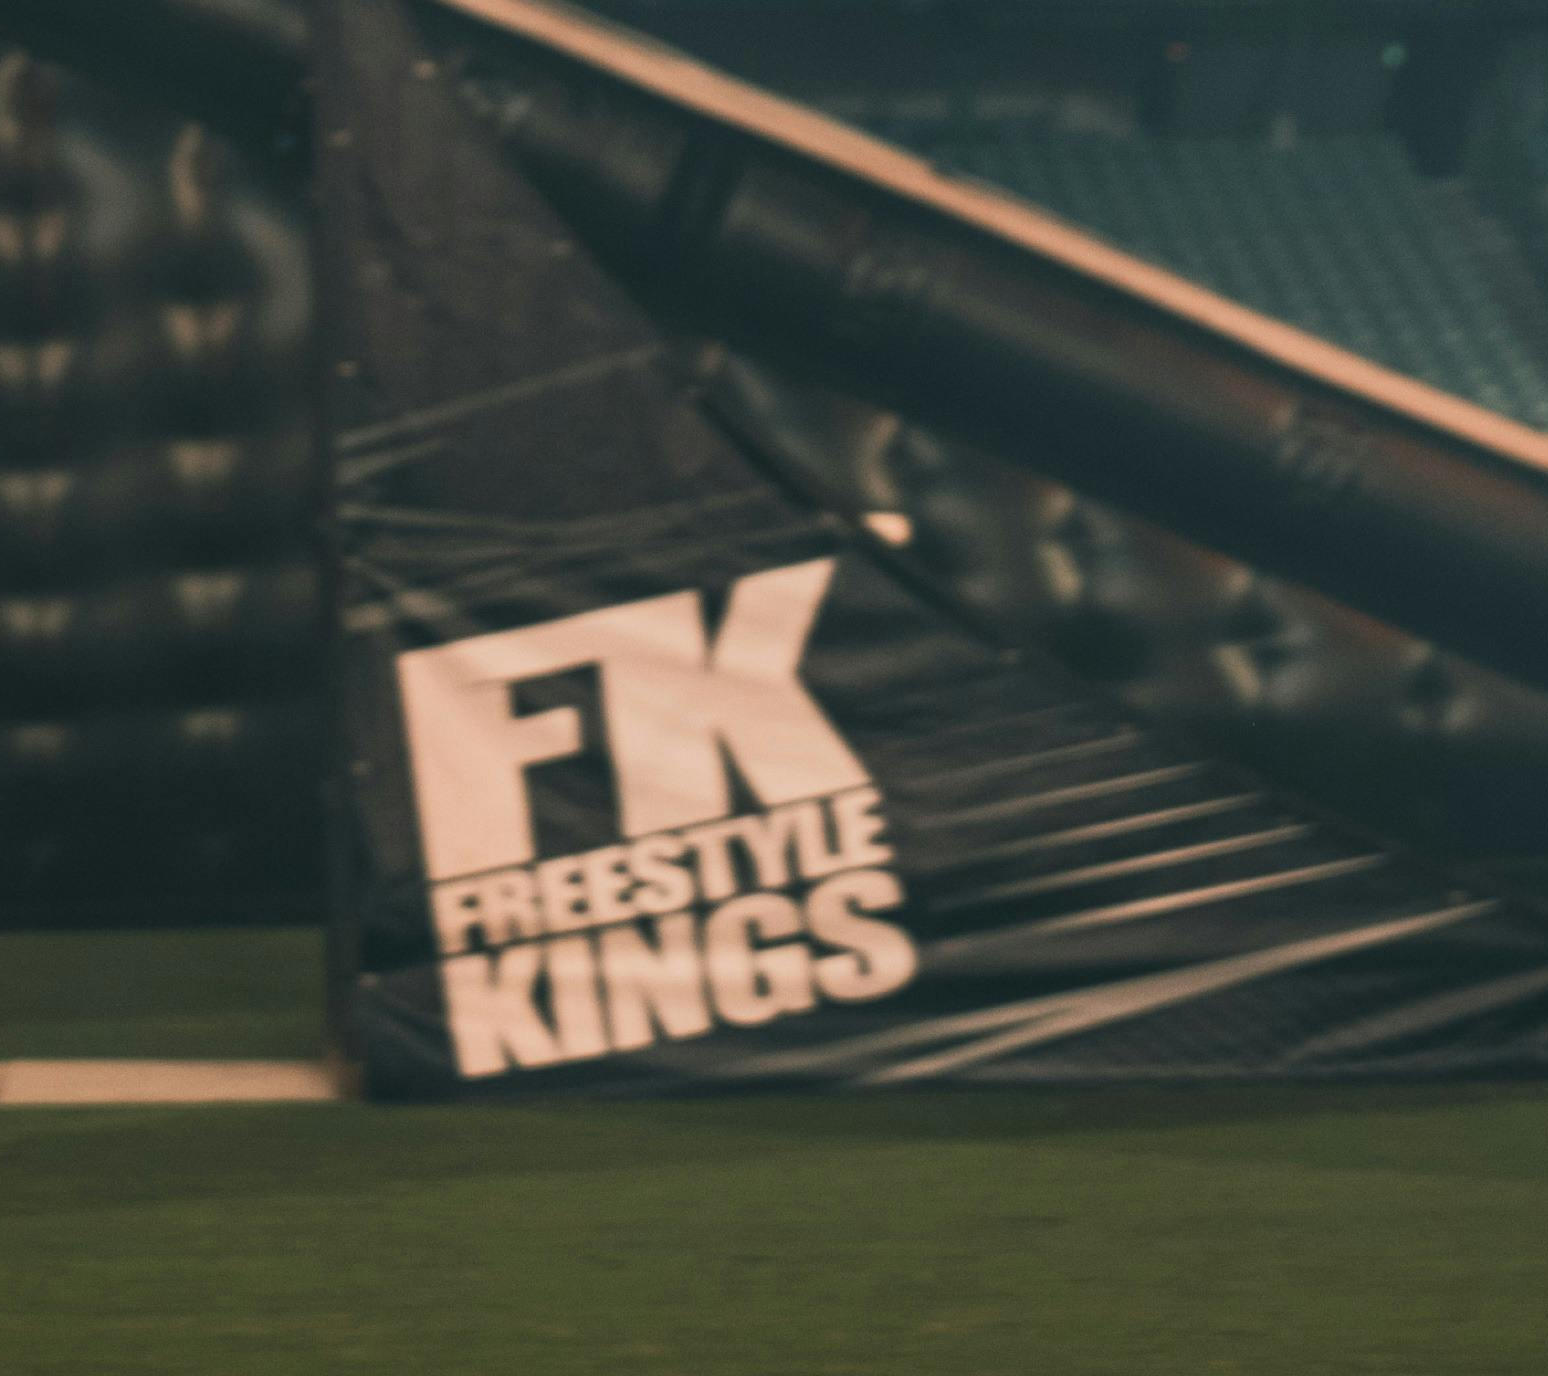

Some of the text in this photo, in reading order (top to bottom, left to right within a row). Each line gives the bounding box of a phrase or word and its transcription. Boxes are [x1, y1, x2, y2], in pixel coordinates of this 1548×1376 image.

[397, 558, 870, 882] FK
[432, 786, 894, 955] FREESTYLE
[444, 870, 917, 1080] KINGS
